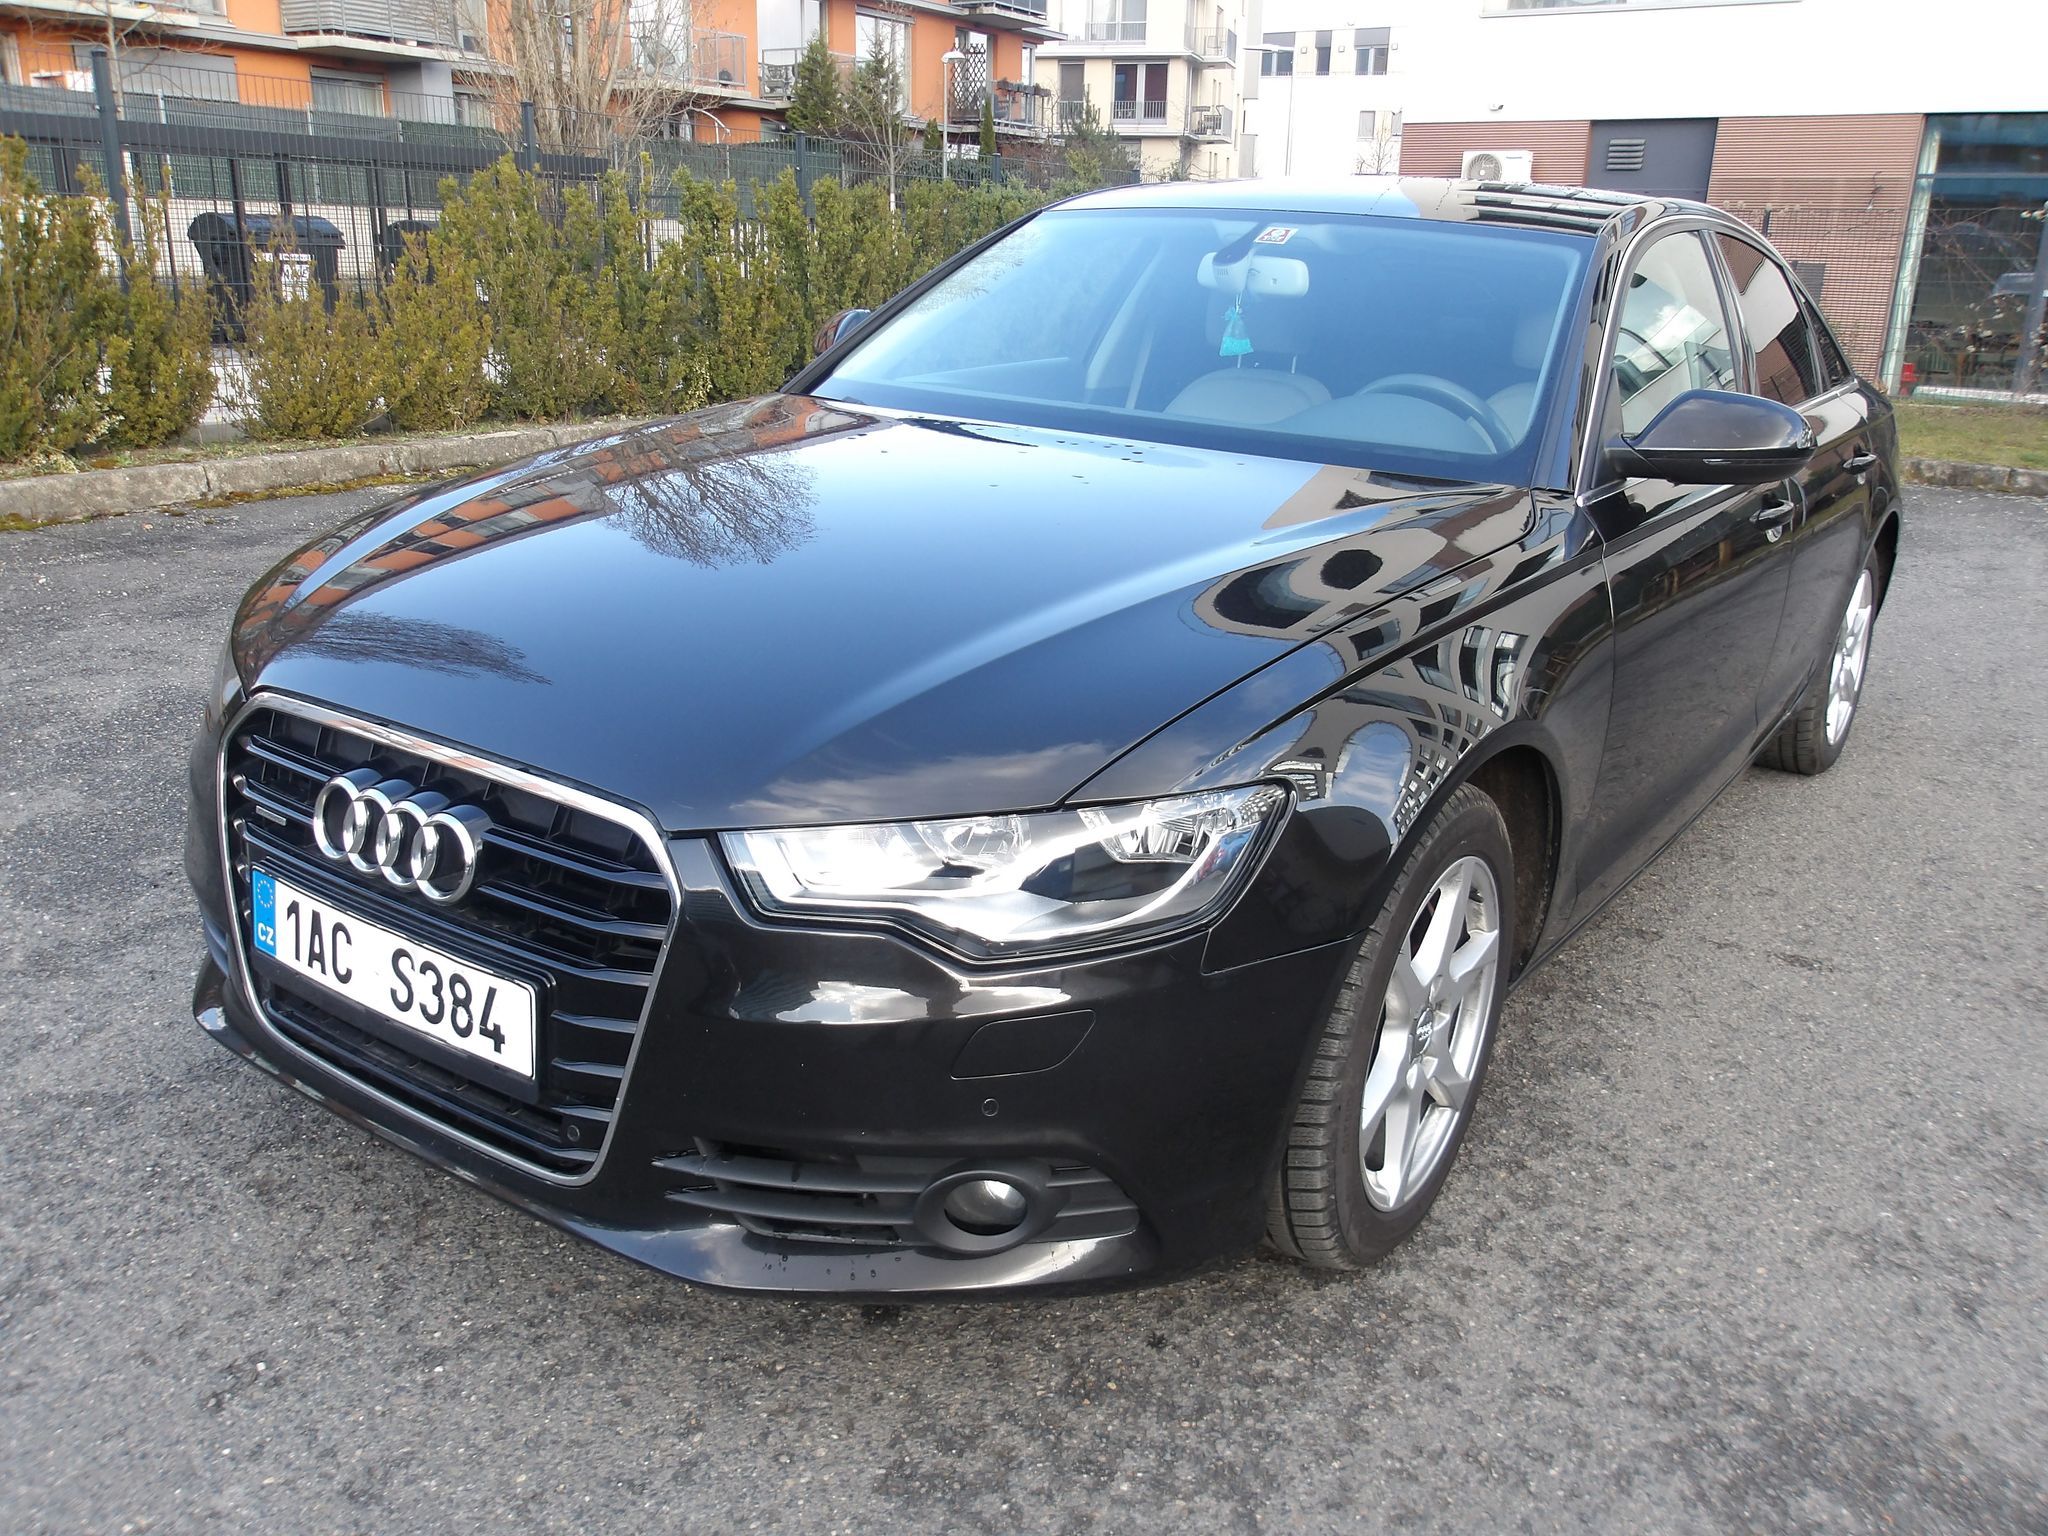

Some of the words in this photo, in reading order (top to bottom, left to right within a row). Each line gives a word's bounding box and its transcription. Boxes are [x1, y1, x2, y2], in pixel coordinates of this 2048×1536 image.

[258, 922, 274, 946] CZ
[287, 900, 352, 984] 1AC
[391, 948, 505, 1054] S384
